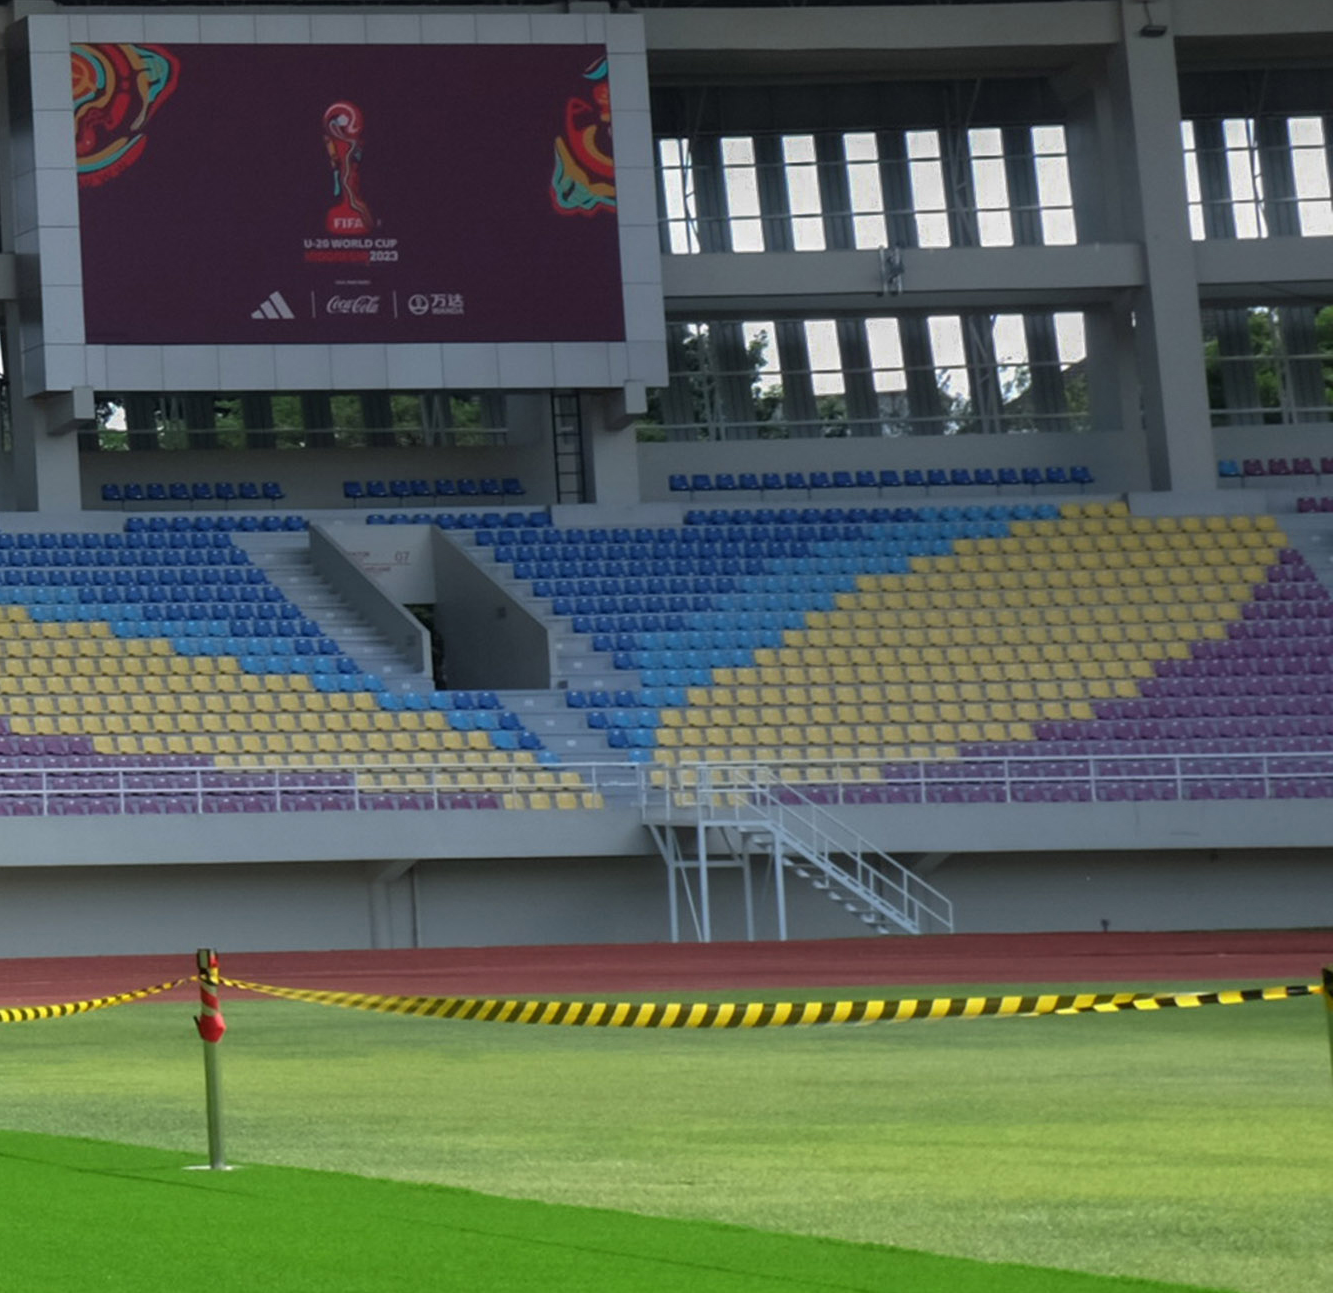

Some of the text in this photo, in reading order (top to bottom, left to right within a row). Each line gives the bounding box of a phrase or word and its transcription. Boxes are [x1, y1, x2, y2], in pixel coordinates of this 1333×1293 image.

[333, 218, 364, 229] FIFA
[303, 239, 398, 249] U-20 WORLD CUP
[369, 250, 399, 261] 2023
